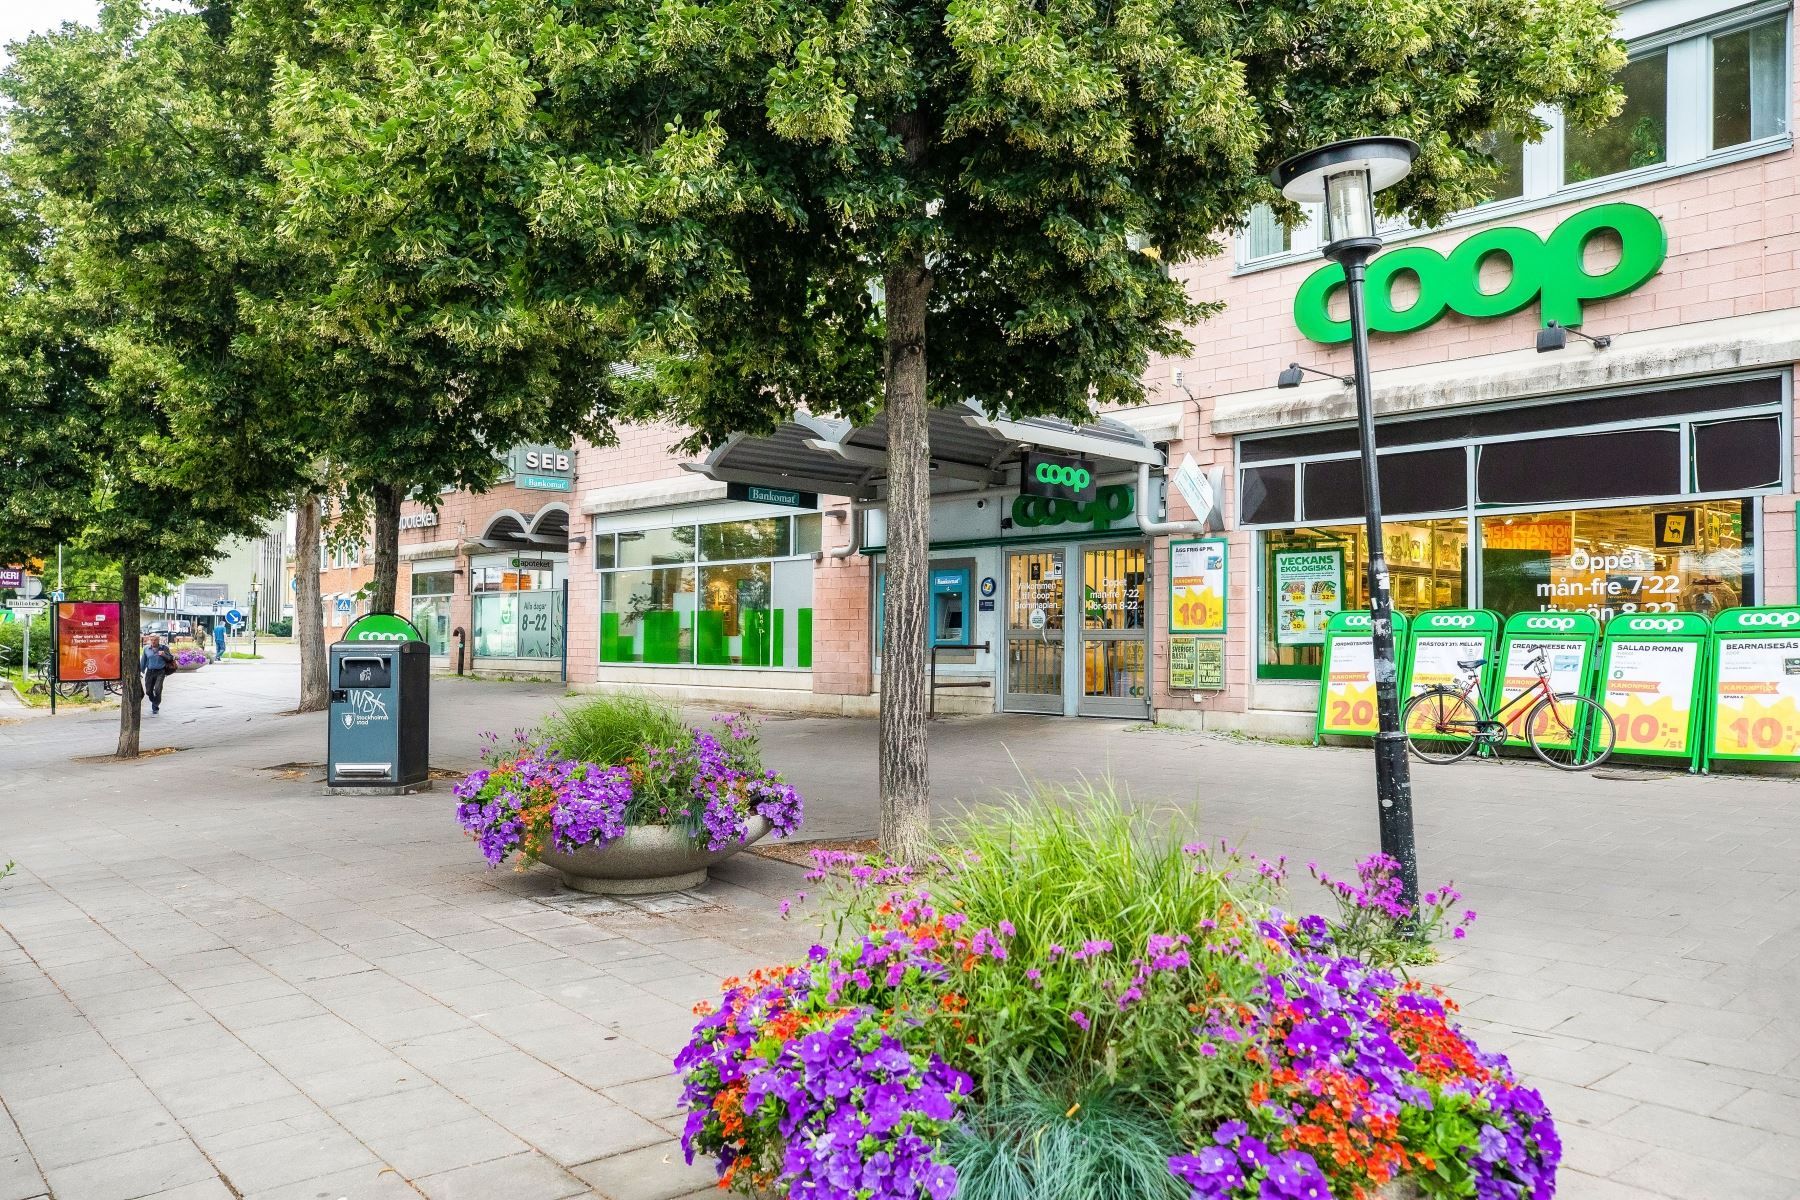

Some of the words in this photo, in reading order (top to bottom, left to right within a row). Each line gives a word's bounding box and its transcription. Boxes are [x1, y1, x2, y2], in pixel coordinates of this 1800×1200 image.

[1294, 202, 1669, 344] coop
[525, 451, 570, 471] SEB
[528, 478, 566, 489] Bankomat
[1035, 462, 1090, 493] coop
[752, 489, 796, 504] Bankomat
[1280, 556, 1334, 565] VECKANS
[1570, 547, 1642, 574] Öppet
[1281, 564, 1336, 573] EKOLOGISKA.
[1122, 589, 1140, 598] 7-22
[1536, 577, 1622, 597] mån-fre
[1627, 575, 1681, 595] 7-22
[1119, 601, 1139, 610] 8-22
[1431, 615, 1475, 628] coop
[1526, 617, 1576, 632] coop
[1629, 618, 1685, 633] coop
[1738, 611, 1800, 628] coop
[1726, 642, 1799, 650] BEARNAISESÅS
